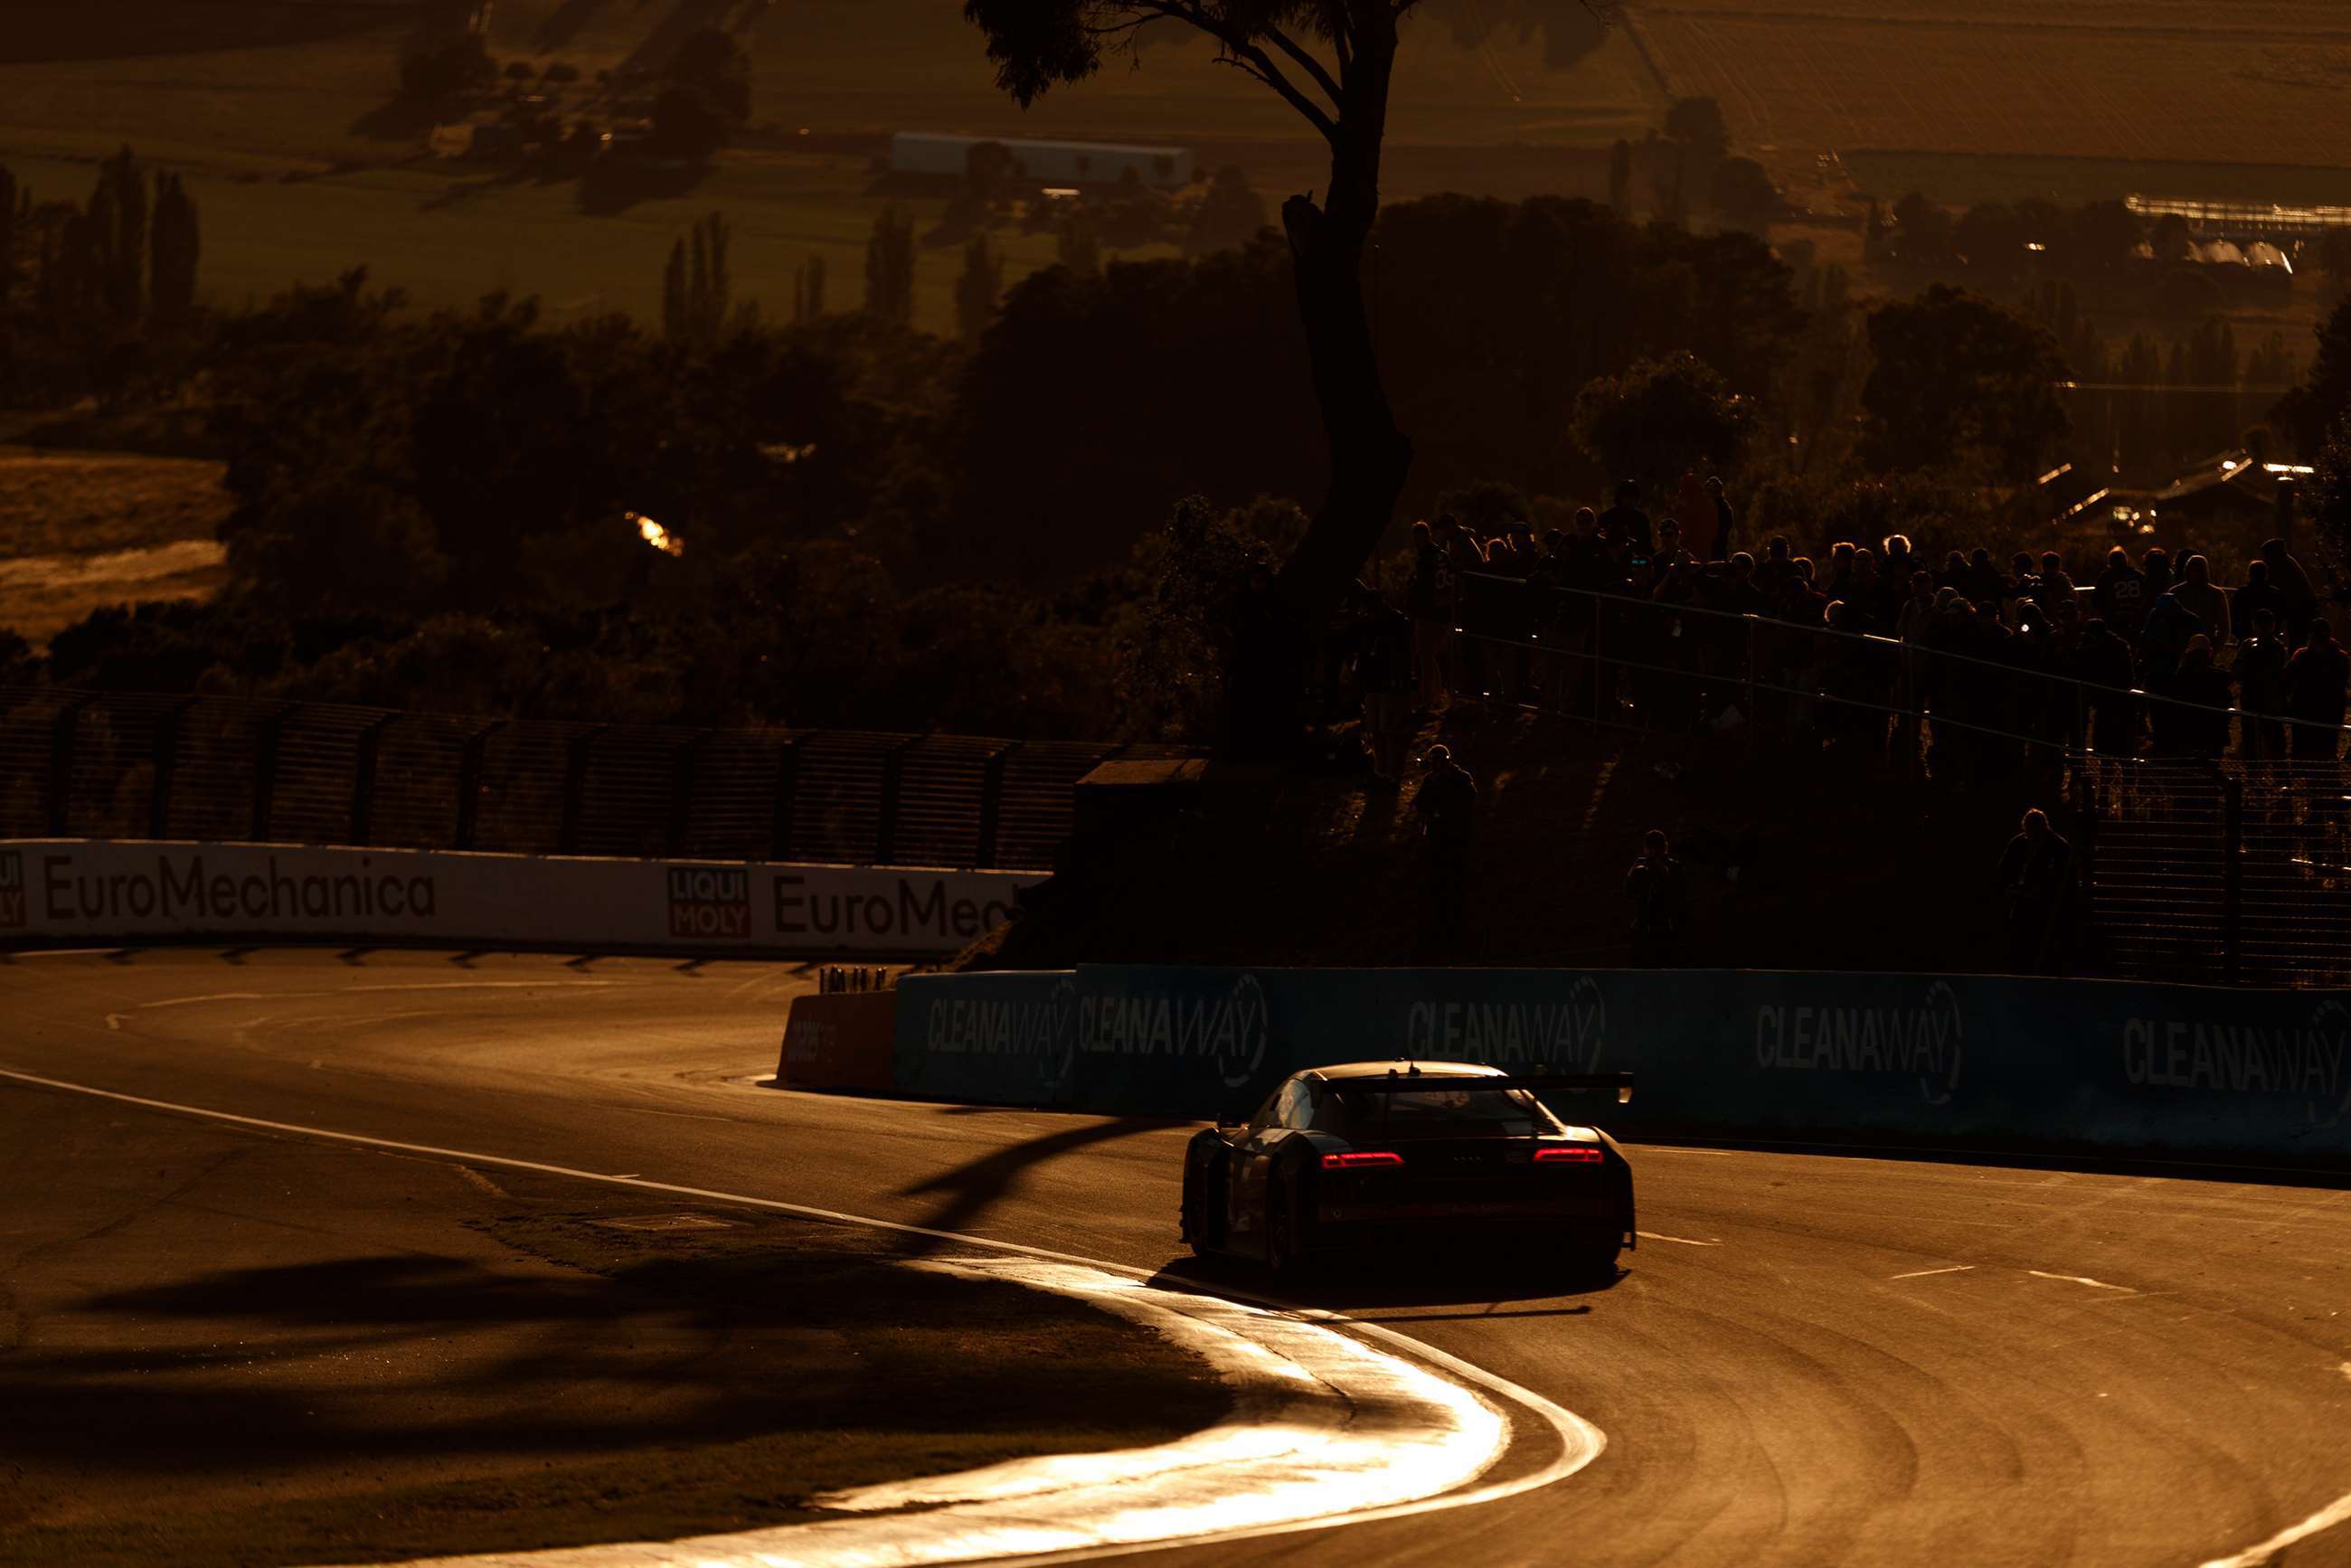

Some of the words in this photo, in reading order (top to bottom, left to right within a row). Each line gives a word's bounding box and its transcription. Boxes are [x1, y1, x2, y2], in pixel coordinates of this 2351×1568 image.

[2113, 580, 2141, 600] 28
[44, 855, 436, 921] EuroMechanica
[671, 868, 746, 902] LIQUI
[673, 904, 751, 935] MOLY
[928, 997, 1071, 1056] CLEANAWAY
[1078, 996, 1257, 1057] CLEANAWAY
[1407, 1000, 1597, 1063] CLEANAWAY
[1756, 1005, 1951, 1072] CLEANAWAY
[2123, 1017, 2346, 1098] CLEANAWAY
